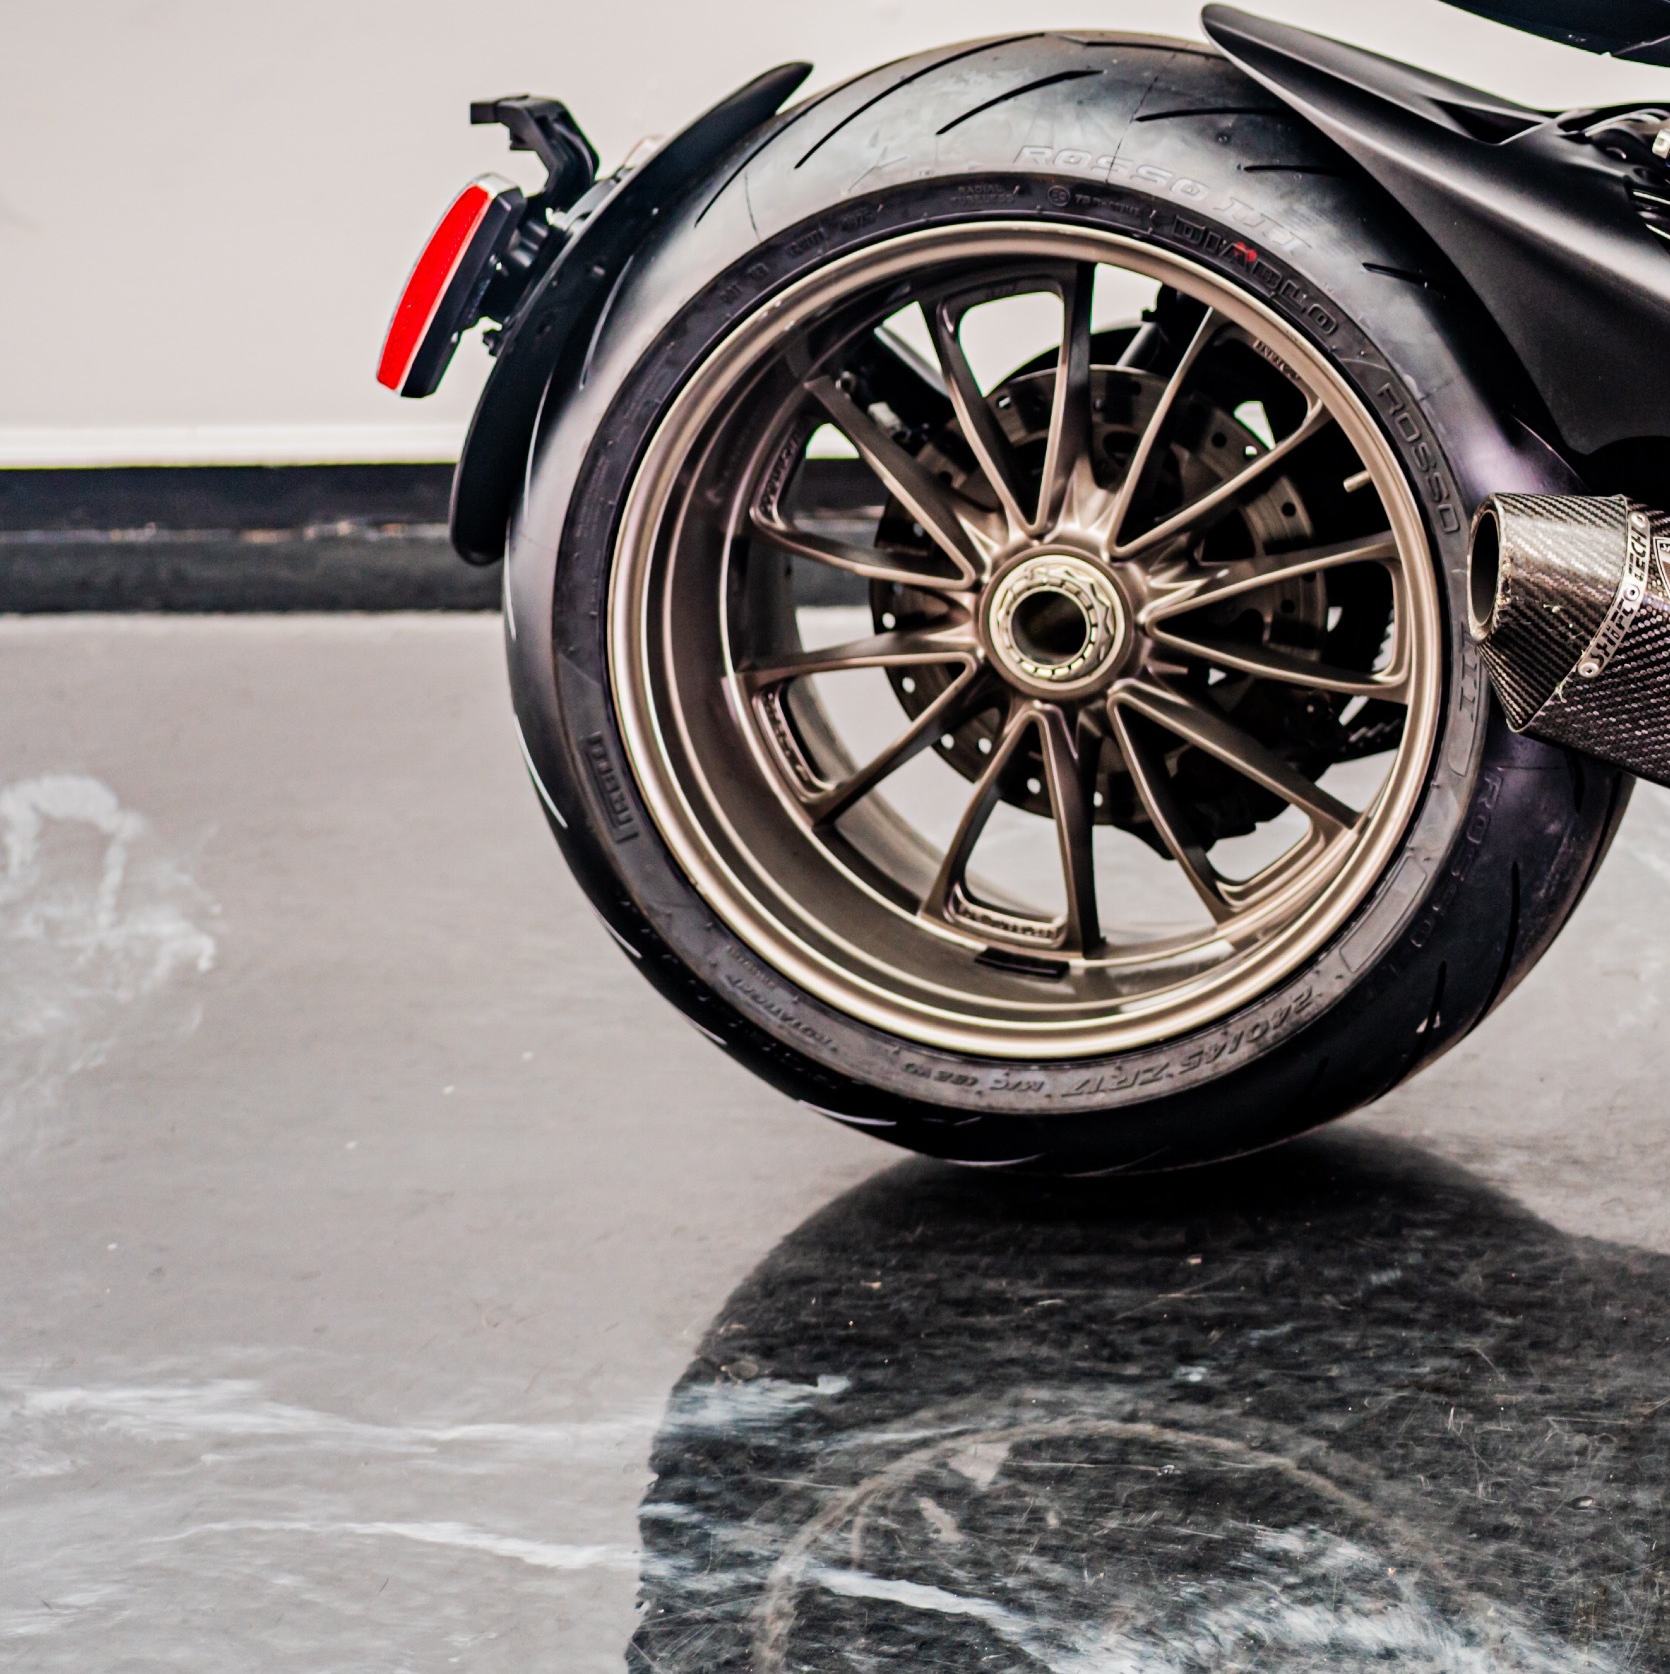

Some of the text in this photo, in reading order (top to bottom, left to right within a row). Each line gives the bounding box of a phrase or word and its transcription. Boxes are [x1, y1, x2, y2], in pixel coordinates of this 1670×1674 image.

[1011, 145, 1212, 204] ROSSO
[1167, 213, 1338, 335] DIABLO
[1373, 379, 1460, 532] ROSSO
